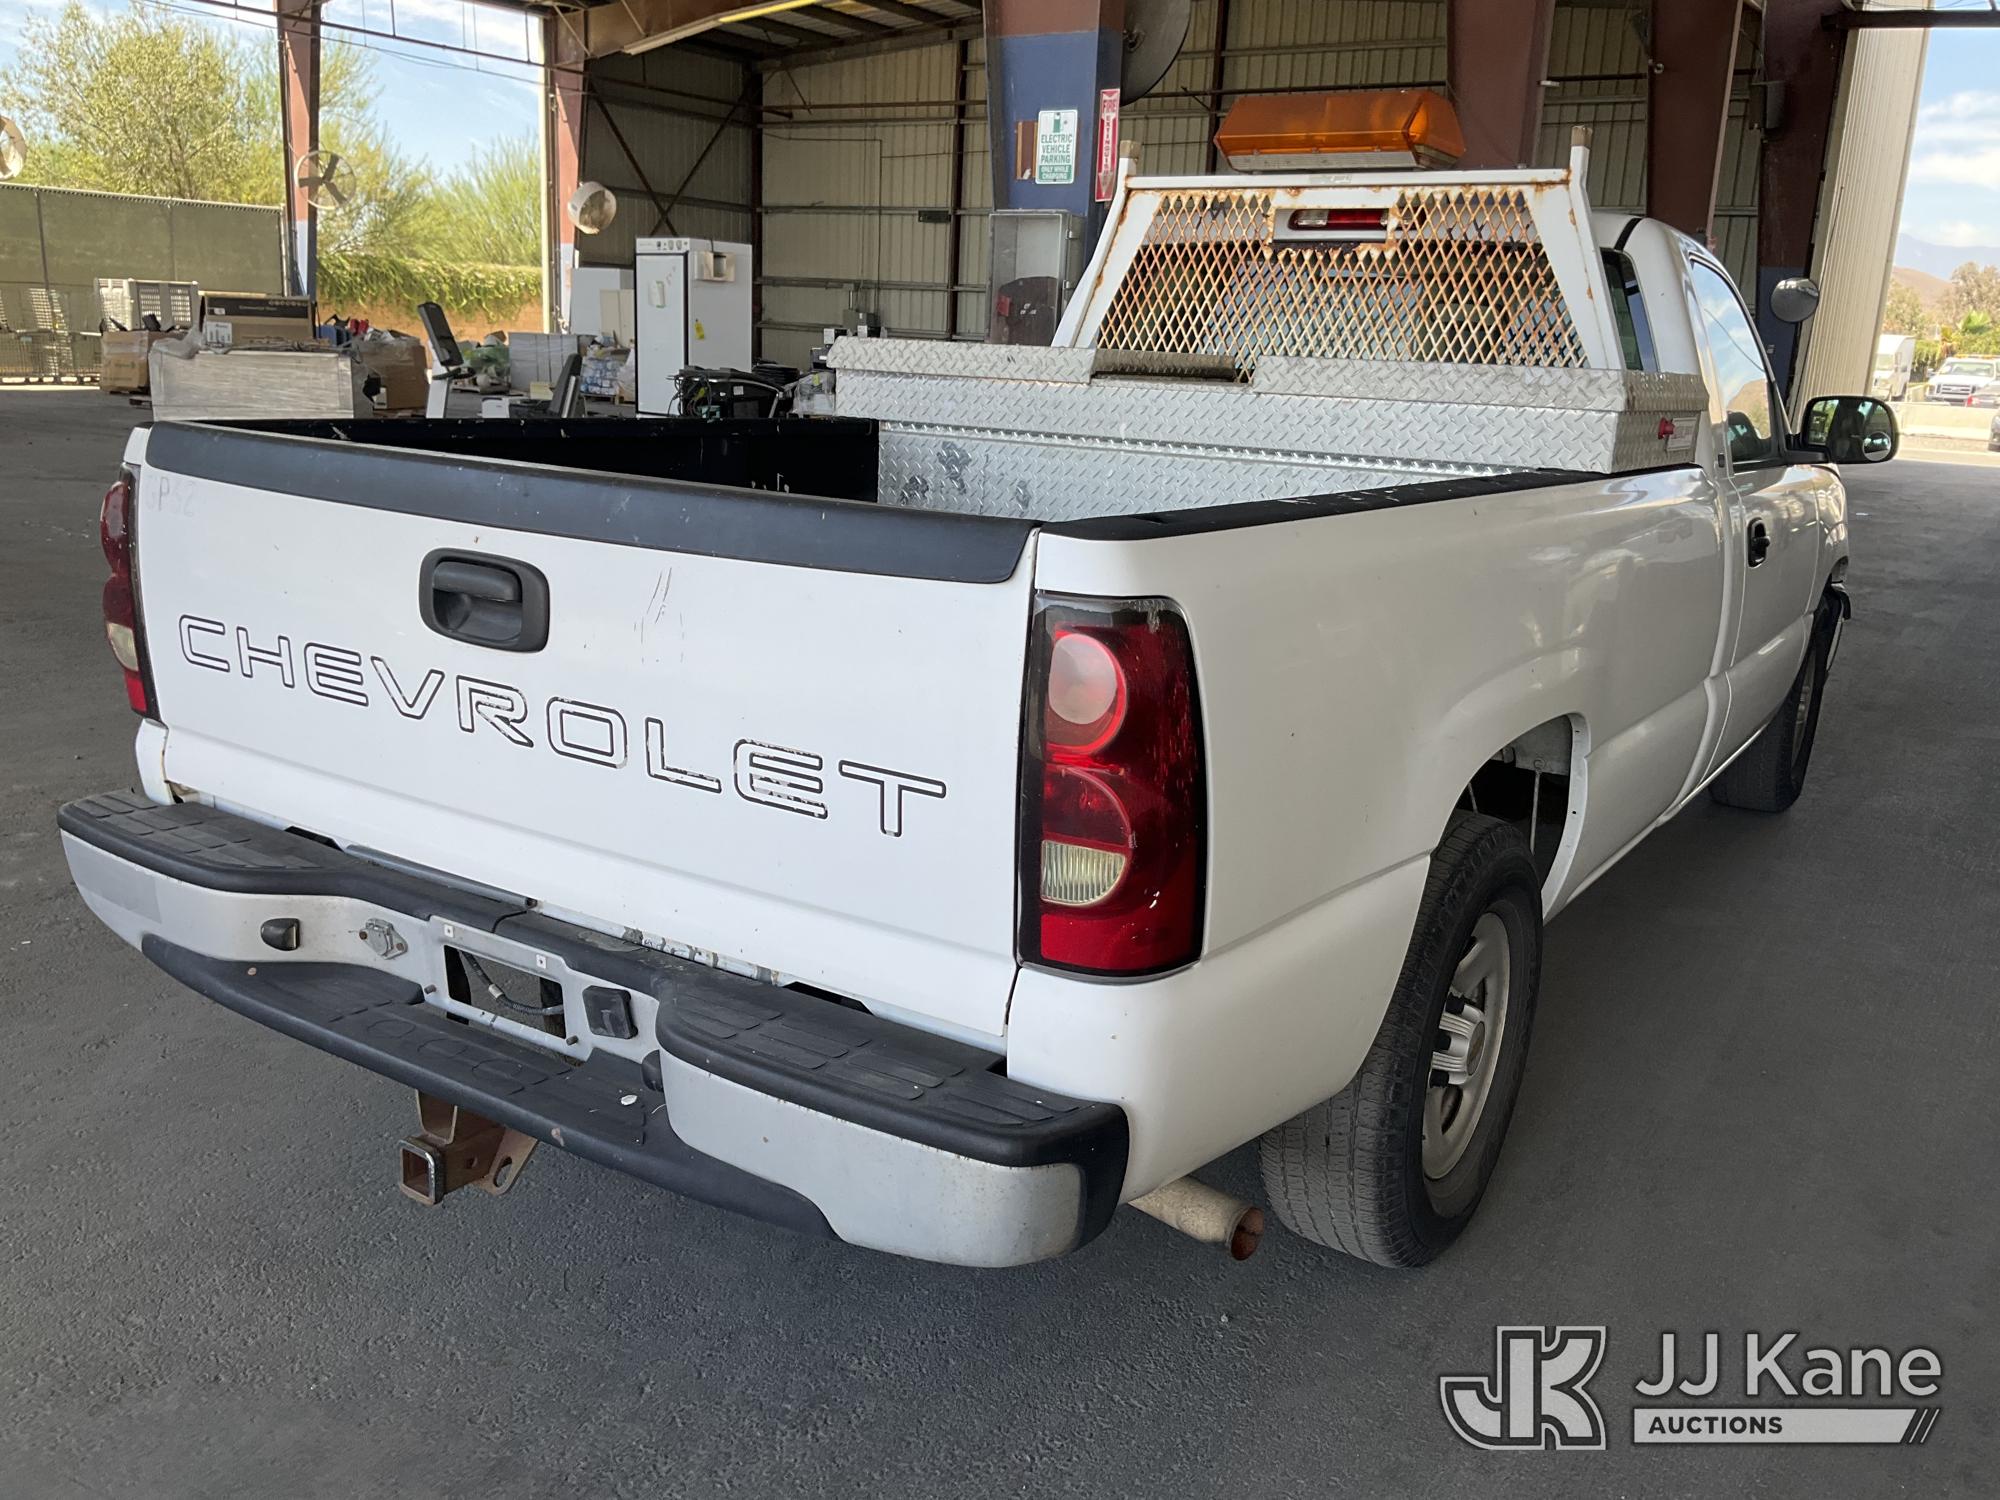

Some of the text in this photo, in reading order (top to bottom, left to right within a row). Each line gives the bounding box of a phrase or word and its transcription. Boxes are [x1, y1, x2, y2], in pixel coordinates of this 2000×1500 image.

[1040, 134, 1073, 144] ELECTRIC
[1041, 144, 1071, 154] VEHICLE
[1040, 154, 1071, 164] PARKING
[179, 614, 947, 838] CHEVROLET
